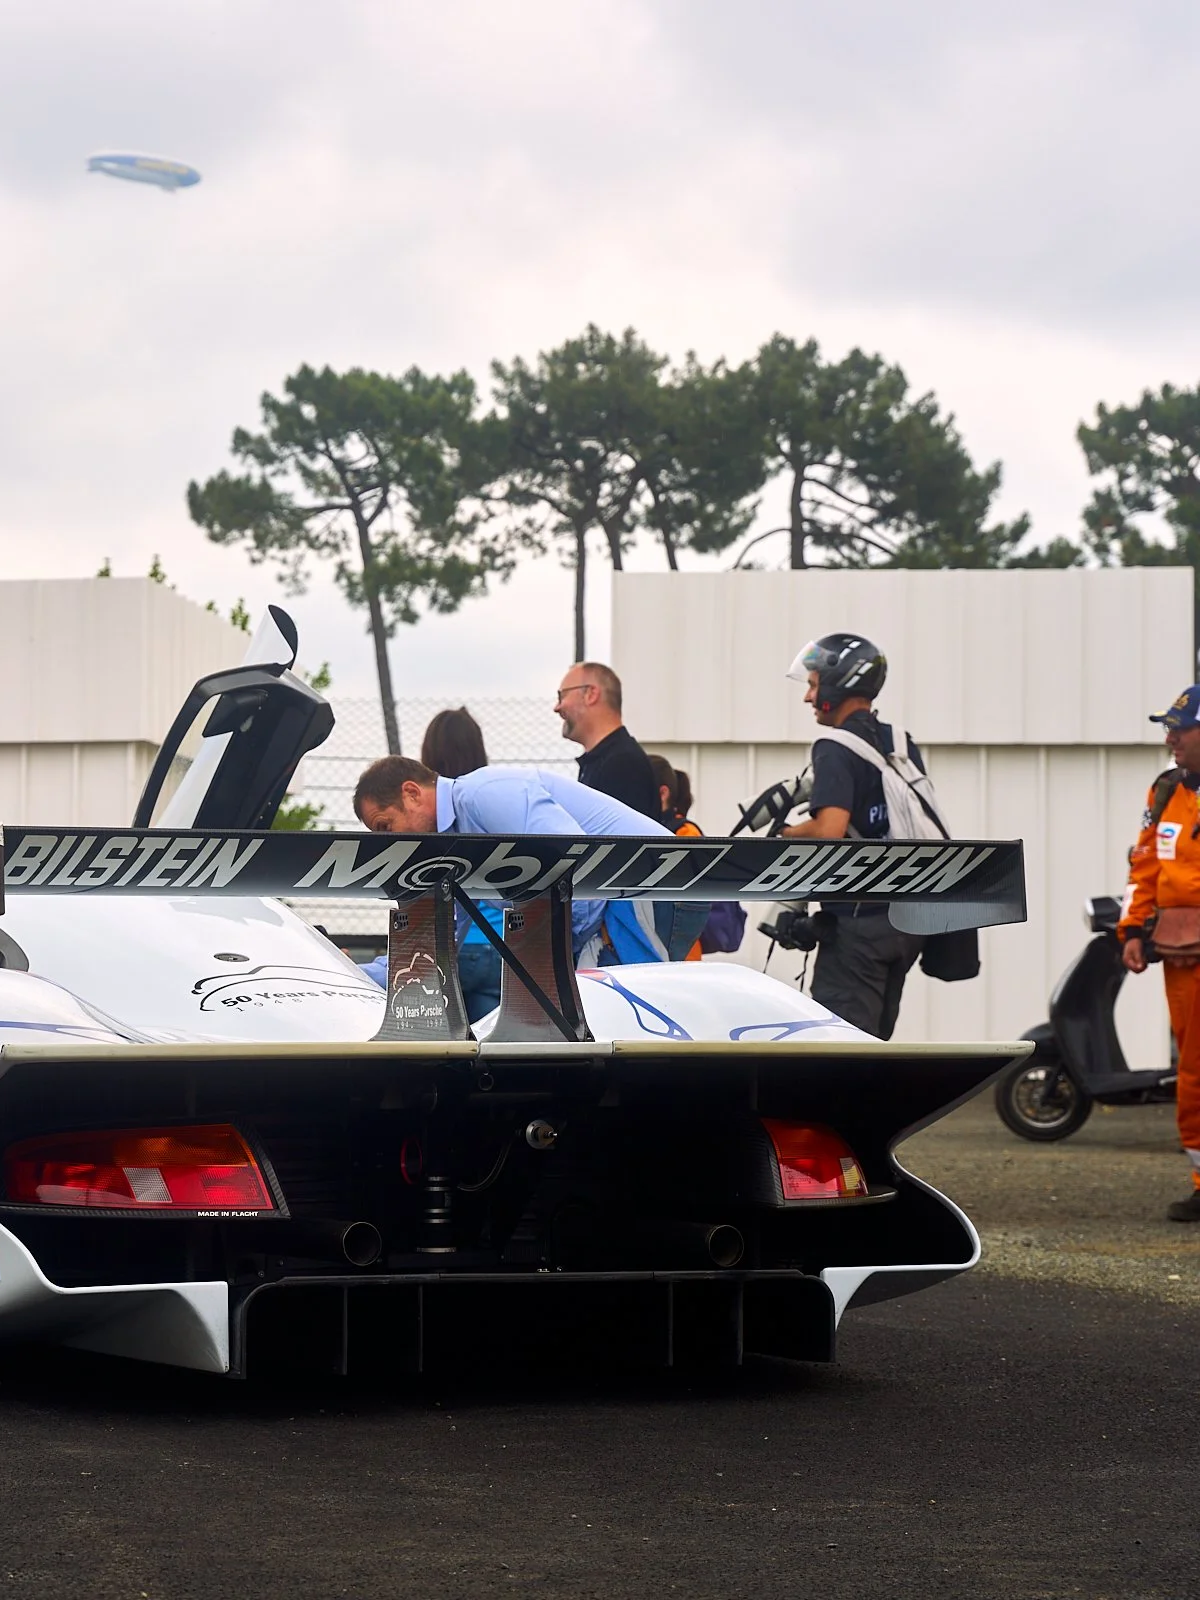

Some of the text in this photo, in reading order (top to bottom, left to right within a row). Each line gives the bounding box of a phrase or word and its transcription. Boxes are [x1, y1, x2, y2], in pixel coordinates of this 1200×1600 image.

[3, 834, 265, 888] BILSTEIN
[293, 839, 616, 891] Mobil
[739, 844, 997, 893] BILSTEIN
[220, 995, 252, 1008] 50
[255, 991, 318, 1000] Years
[395, 1004, 442, 1018] 50 Years Porsche
